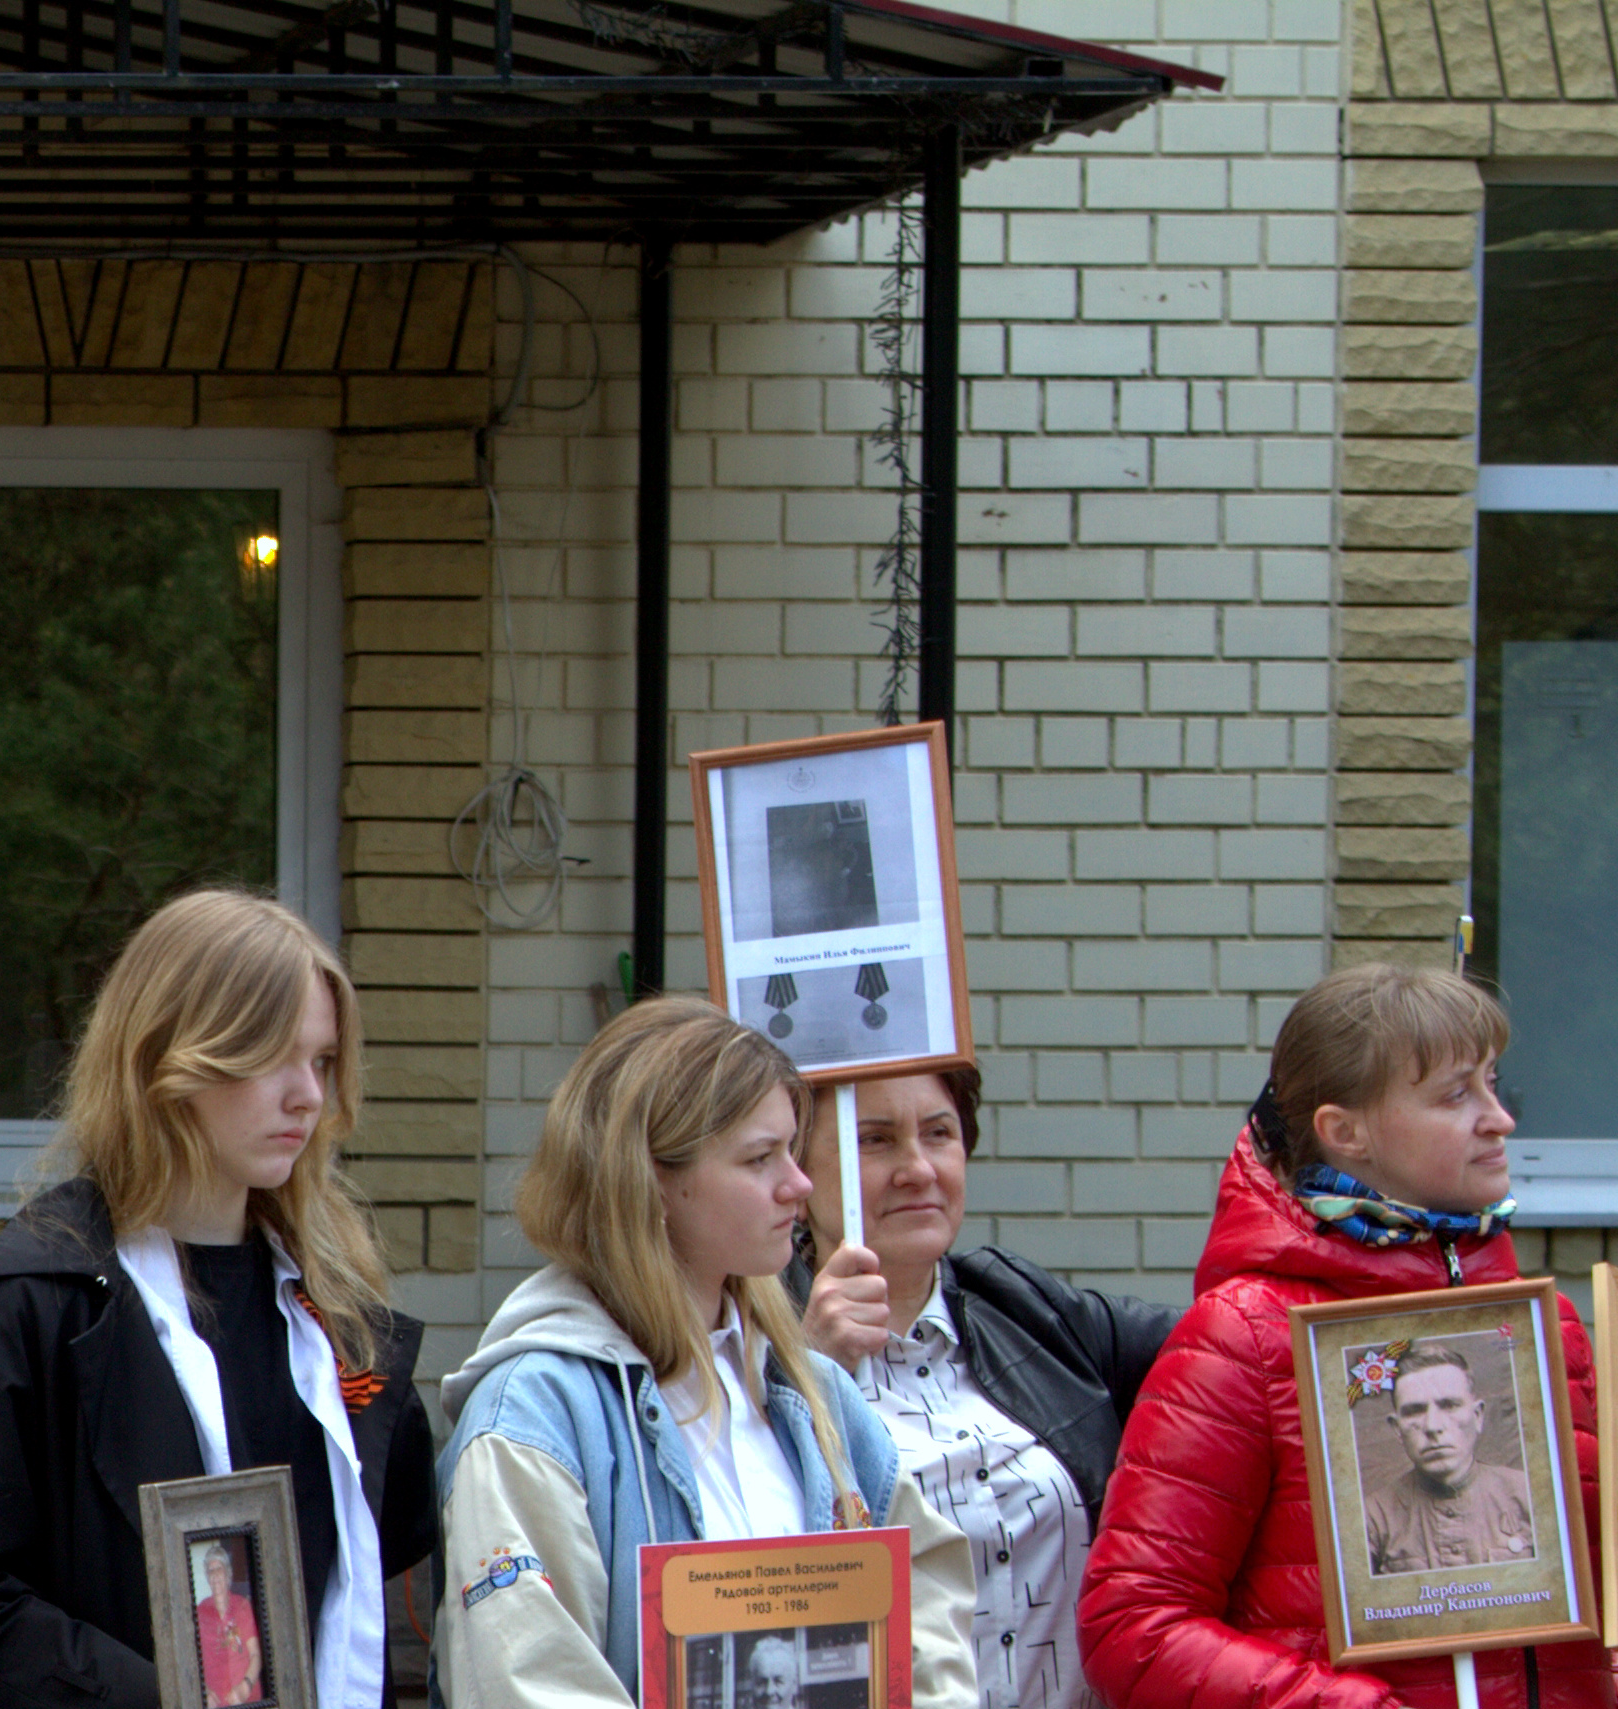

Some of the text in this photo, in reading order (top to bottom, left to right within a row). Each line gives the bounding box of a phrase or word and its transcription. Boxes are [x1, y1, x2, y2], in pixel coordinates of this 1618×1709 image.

[823, 950, 848, 960] Илья
[688, 1560, 864, 1583] Емельянов Павел Васильевич
[714, 1580, 839, 1599] Рядовой артиллерии
[1418, 1580, 1493, 1600] Дербасов
[745, 1601, 772, 1615] 1903
[783, 1599, 810, 1612] 1986
[1363, 1589, 1552, 1621] Владимир Капитонович
